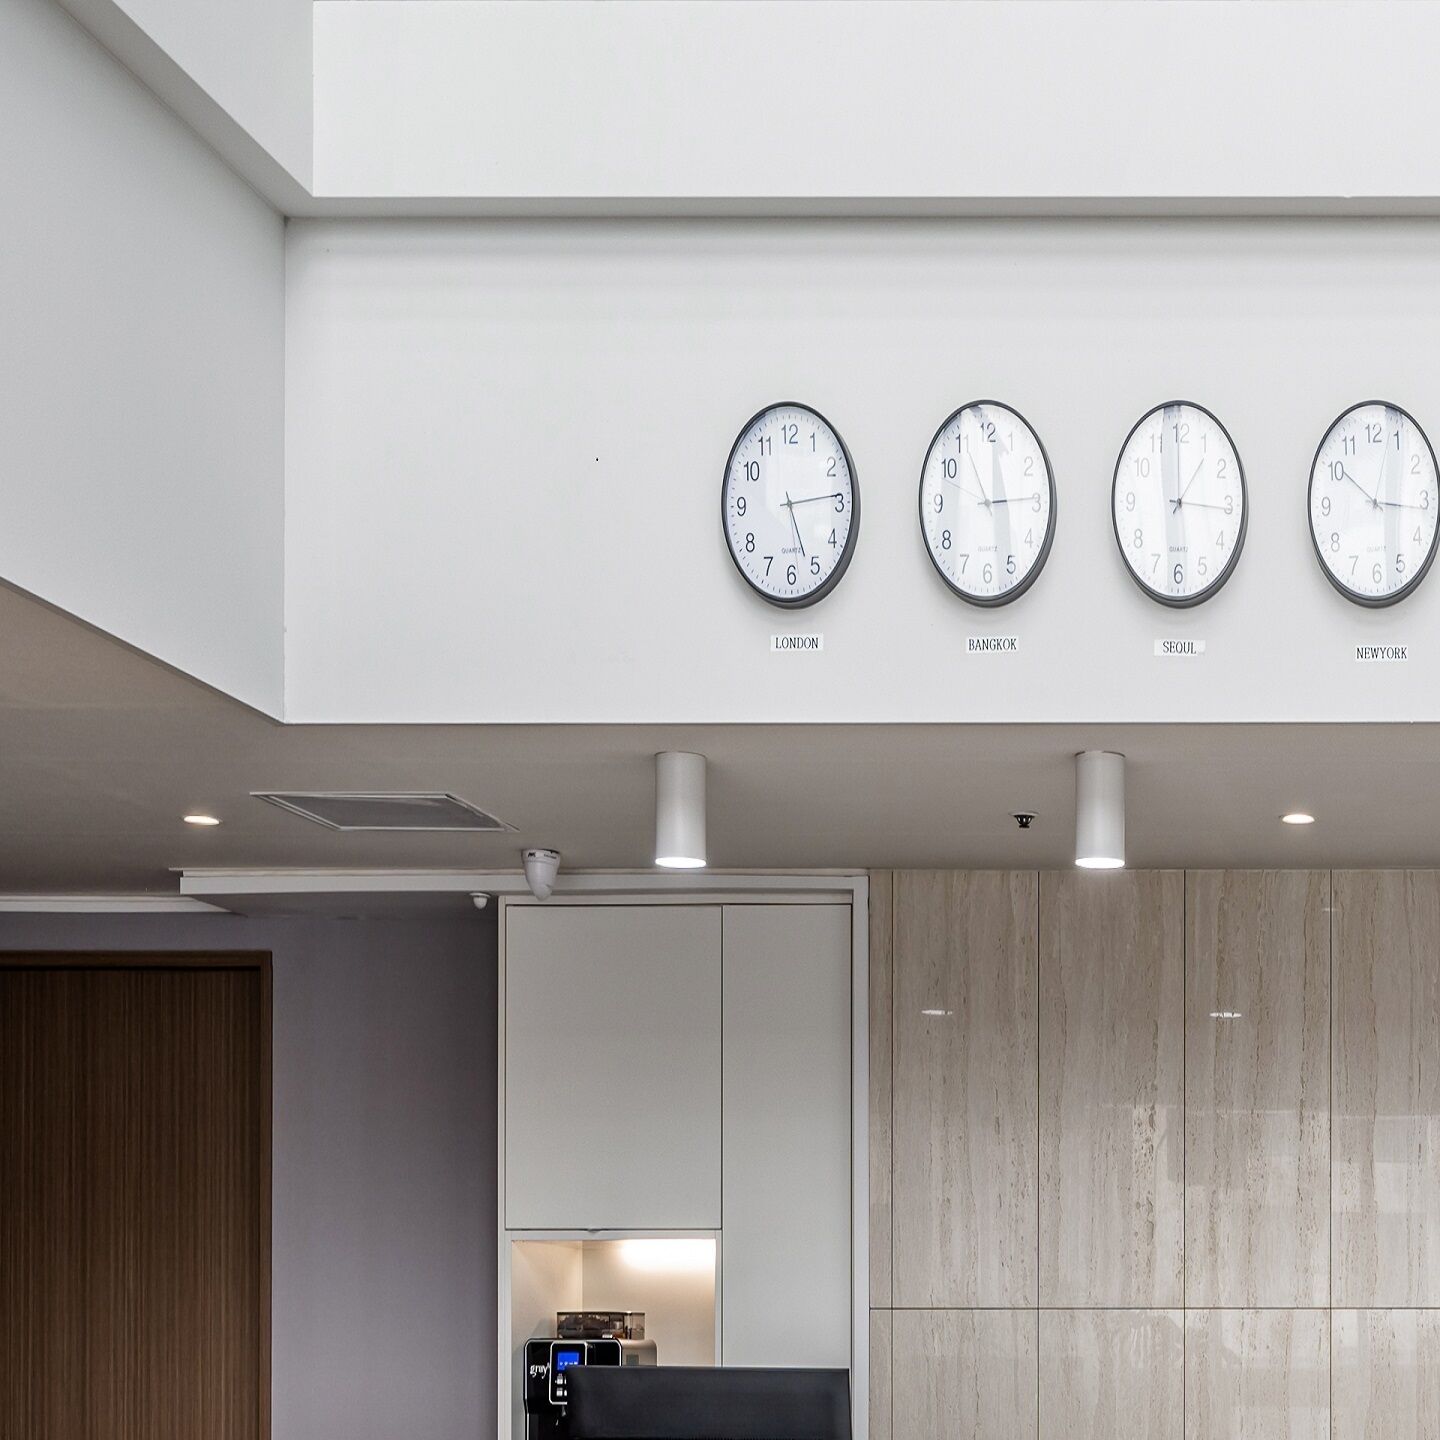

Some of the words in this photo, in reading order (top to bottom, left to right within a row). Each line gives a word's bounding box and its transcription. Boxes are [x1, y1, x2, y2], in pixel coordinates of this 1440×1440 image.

[781, 423, 799, 444] 12
[810, 432, 816, 452] 1
[980, 422, 996, 443] 12
[1008, 432, 1013, 451] 1
[1172, 423, 1189, 444] 12
[1365, 423, 1382, 443] 12
[1393, 430, 1400, 450] 1
[758, 436, 772, 456] 11
[956, 434, 969, 454] 11
[1150, 433, 1163, 453] 11
[1201, 433, 1207, 453] 1
[1342, 435, 1356, 455] 11
[743, 461, 760, 482] 10
[826, 456, 836, 477] 2
[941, 458, 957, 479] 10
[1024, 456, 1034, 476] 2
[1134, 457, 1150, 478] 10
[1217, 459, 1226, 479] 2
[1328, 460, 1345, 481] 10
[1411, 454, 1421, 474] 2
[737, 496, 747, 516] 9
[834, 493, 845, 513] 3
[933, 494, 943, 513] 9
[1031, 493, 1041, 513] 3
[1126, 492, 1136, 512] 9
[1224, 495, 1234, 515] 3
[1321, 496, 1331, 516] 9
[1419, 490, 1429, 510] 3
[745, 533, 755, 553] 8
[828, 528, 837, 548] 4
[941, 530, 951, 550] 8
[1024, 528, 1034, 548] 4
[1133, 528, 1143, 549] 8
[1215, 531, 1225, 550] 4
[1330, 532, 1340, 553] 8
[1412, 526, 1422, 545] 4
[763, 556, 773, 576] 7
[810, 556, 820, 575] 5
[960, 554, 970, 574] 7
[983, 563, 993, 584] 6
[1006, 555, 1016, 574] 5
[1151, 553, 1161, 574] 7
[1197, 557, 1207, 576] 5
[1349, 555, 1359, 576] 7
[1372, 563, 1382, 584] 6
[1395, 554, 1406, 573] 5
[786, 564, 797, 585] 6
[1173, 564, 1183, 584] 6
[775, 636, 819, 650] LONDON
[968, 638, 1017, 651] BANGKOK
[1162, 641, 1197, 655] SEOUL
[1356, 646, 1408, 660] NEWYORK
